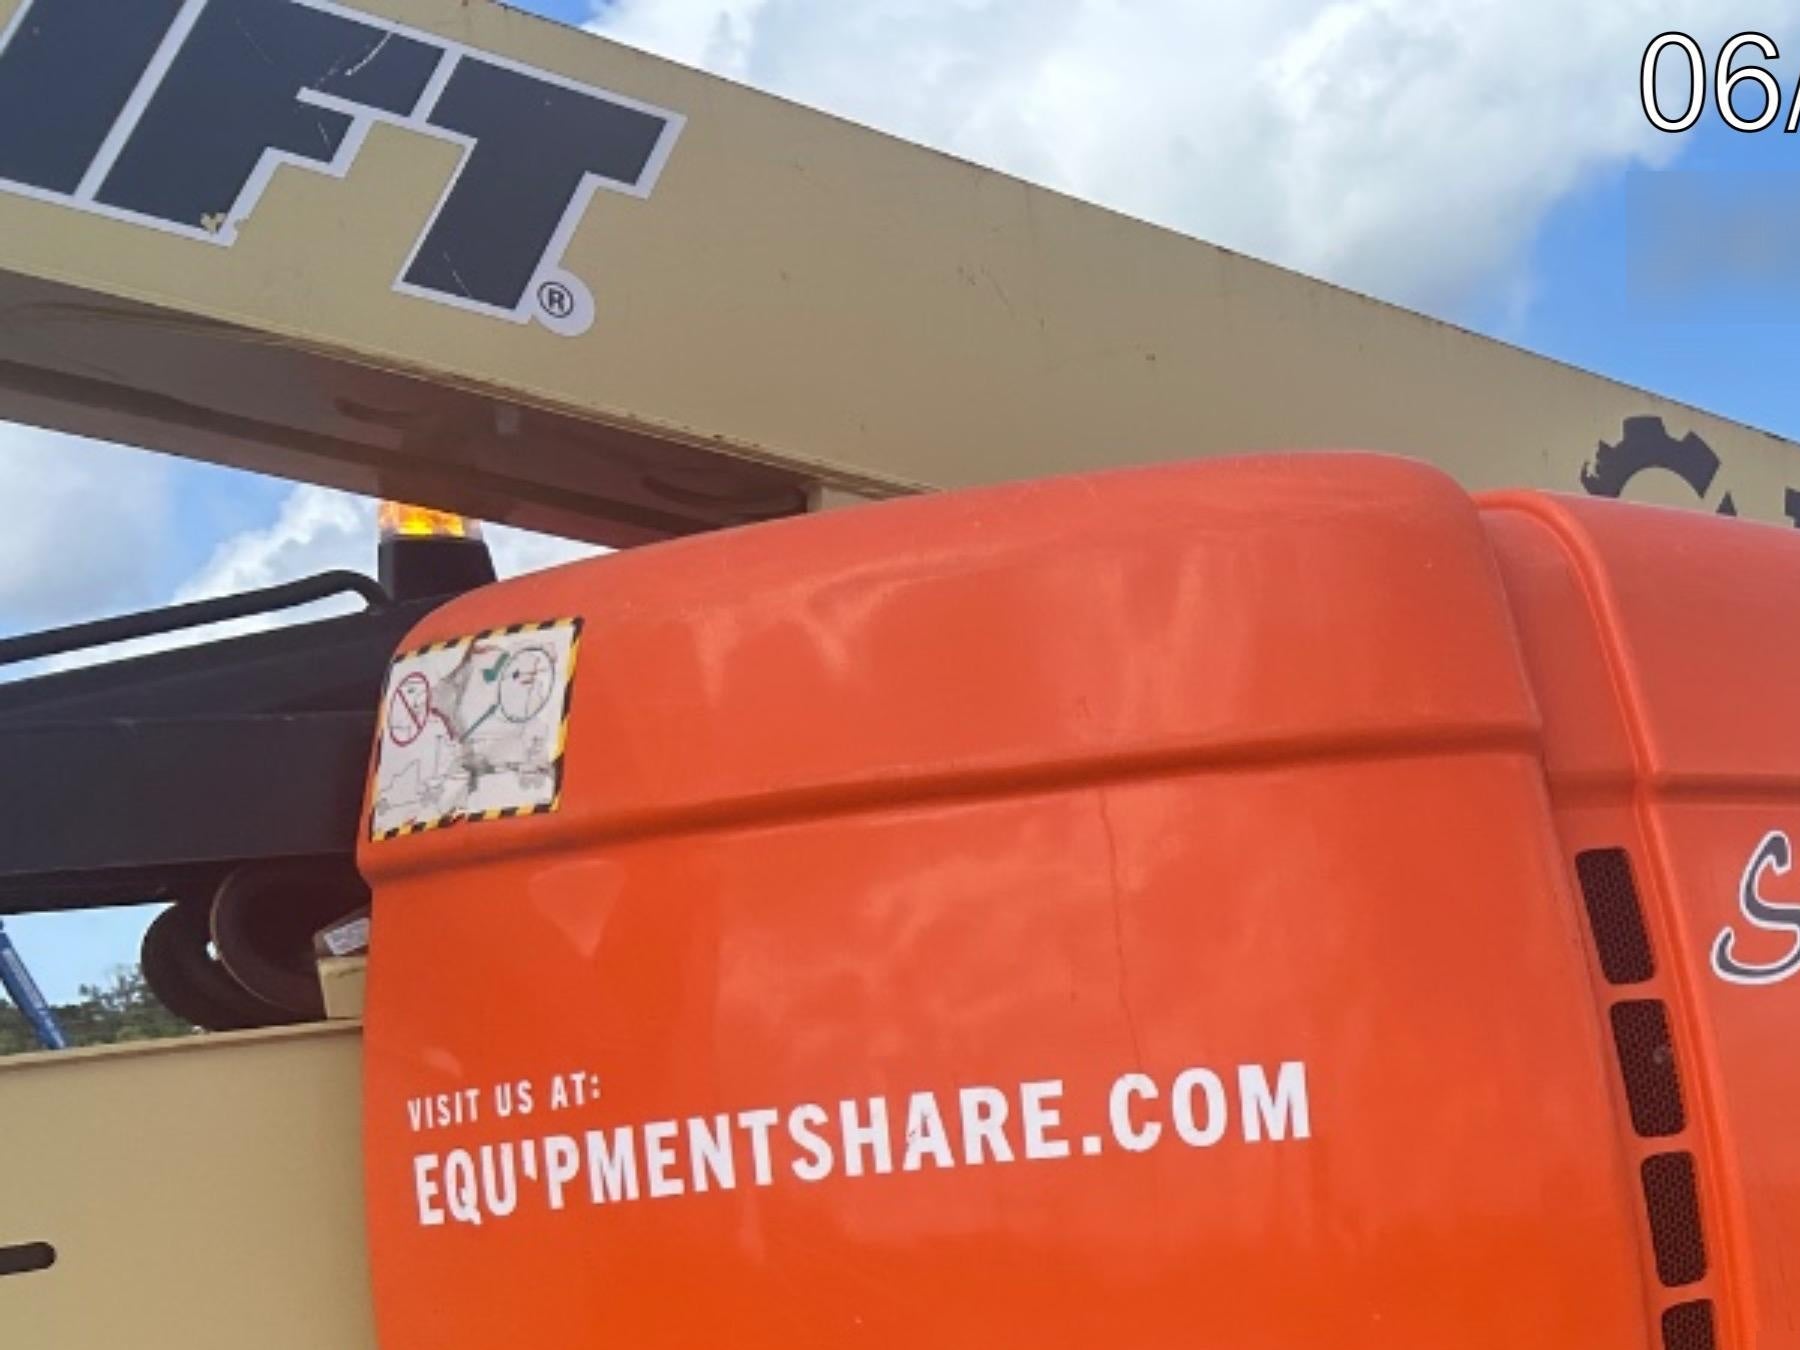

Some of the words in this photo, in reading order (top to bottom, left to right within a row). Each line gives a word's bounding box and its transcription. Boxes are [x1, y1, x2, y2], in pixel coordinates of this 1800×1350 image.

[408, 1088, 480, 1132] VISIT
[494, 1079, 534, 1117] US
[550, 1071, 600, 1111] AT:
